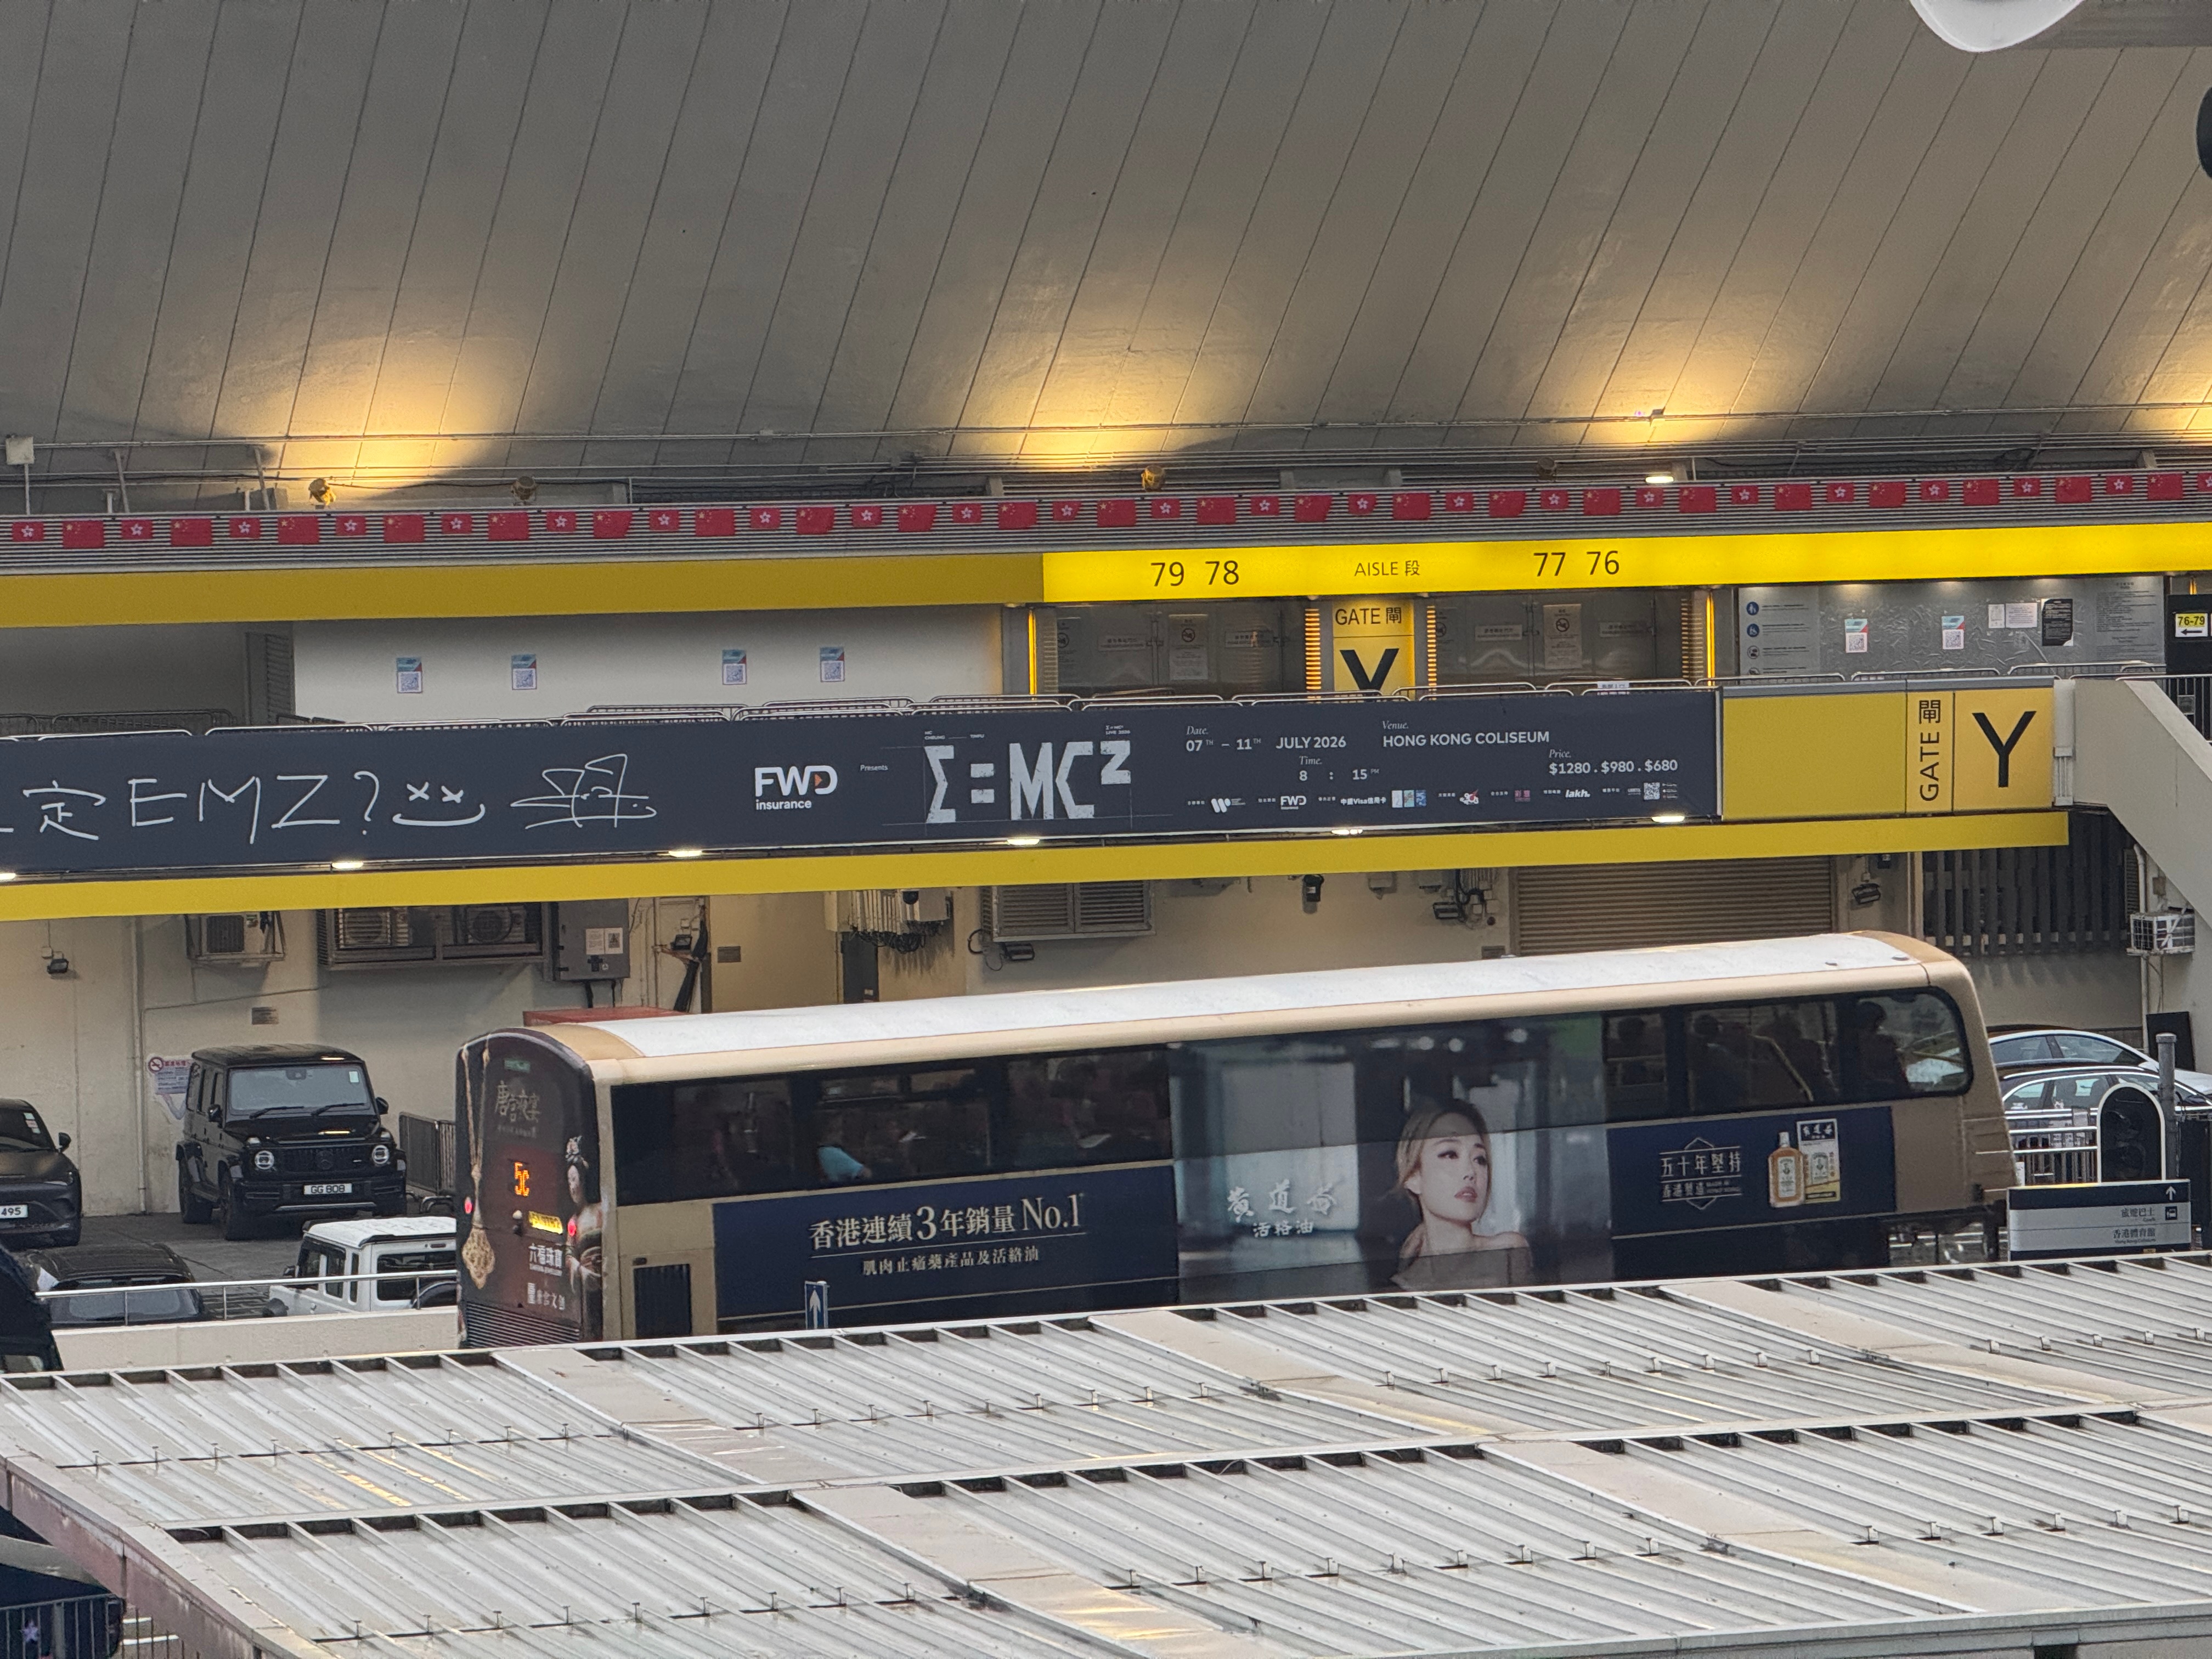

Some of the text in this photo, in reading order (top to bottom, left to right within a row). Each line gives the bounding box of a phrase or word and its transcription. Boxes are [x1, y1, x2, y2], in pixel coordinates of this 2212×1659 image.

[1354, 560, 1420, 577] AISLE 段
[1533, 550, 1620, 577] 77 76
[1150, 560, 1239, 587] 79 78
[1335, 607, 1402, 625] GATE 閘
[2177, 616, 2205, 625] 76-79
[1276, 736, 1310, 749] JULY
[1313, 736, 1347, 748] 2026
[1383, 731, 1549, 747] HONG KONG COLISEUM
[1918, 699, 1941, 802] GATE 閘
[1972, 710, 2037, 788] Y
[1299, 770, 1308, 781] 8
[1549, 762, 1591, 776] $1280
[1601, 760, 1634, 774] $980
[1645, 759, 1678, 772] $680
[754, 765, 838, 797] FWD
[755, 799, 812, 810] insurance
[1280, 795, 1307, 806] FWD
[0, 780, 106, 840] 定
[1660, 1151, 1741, 1177] 五十年堅持
[311, 1184, 345, 1194] GG 808
